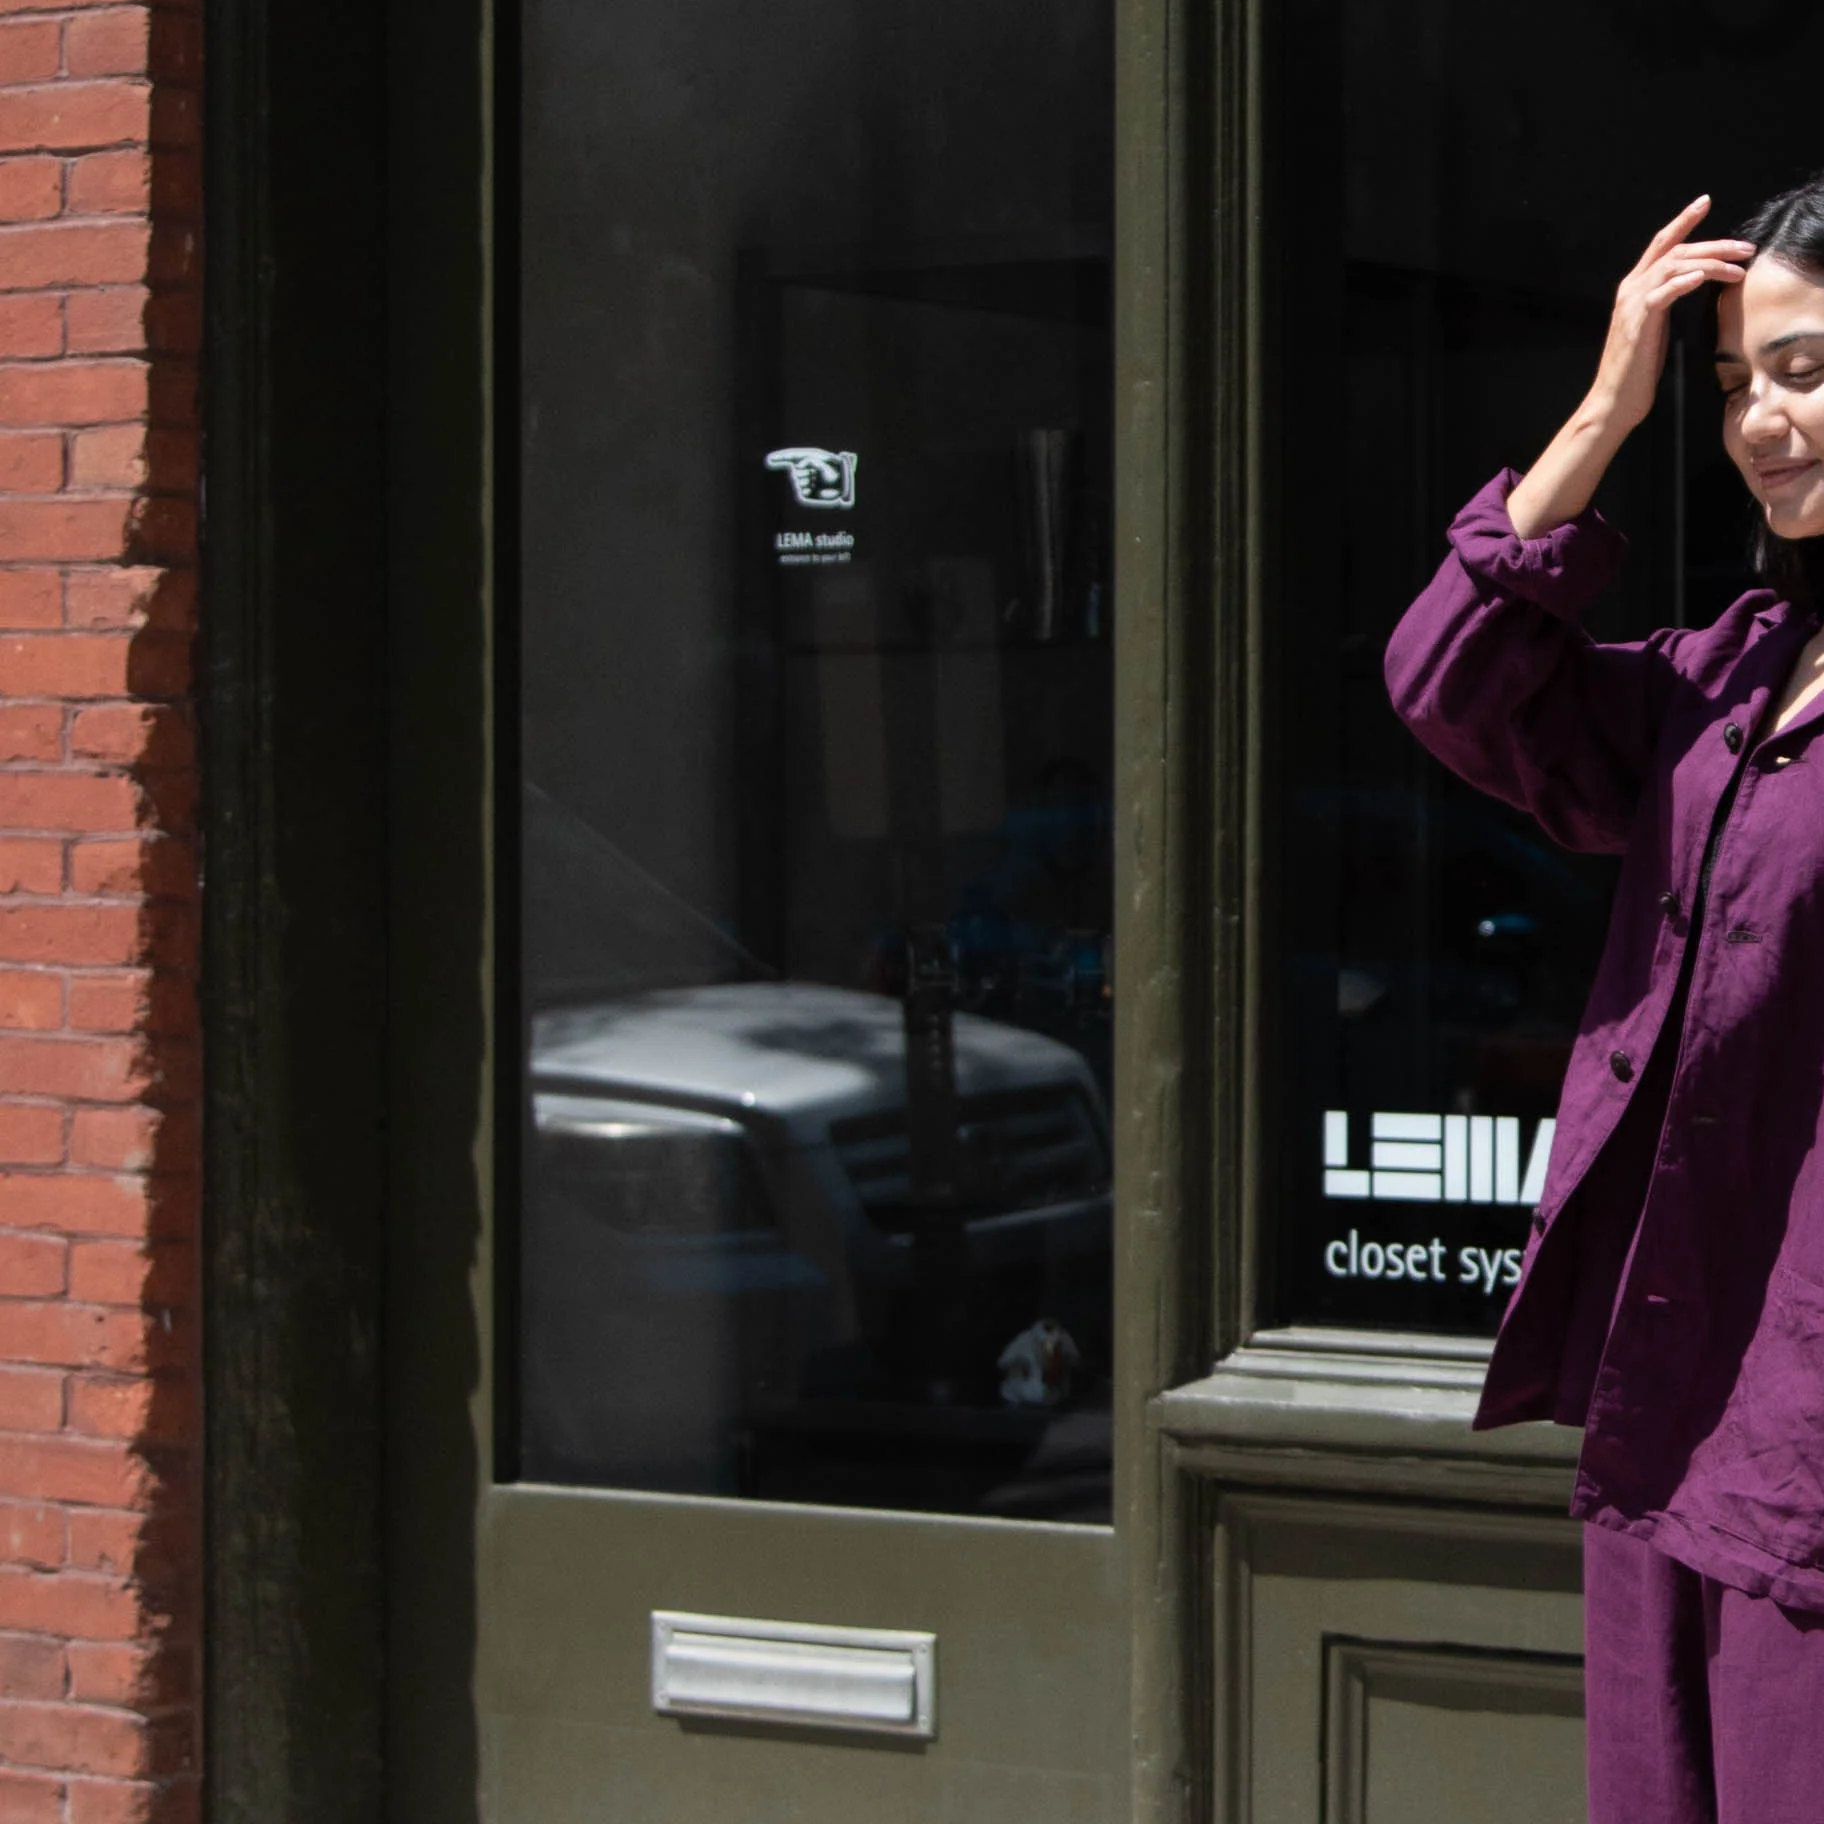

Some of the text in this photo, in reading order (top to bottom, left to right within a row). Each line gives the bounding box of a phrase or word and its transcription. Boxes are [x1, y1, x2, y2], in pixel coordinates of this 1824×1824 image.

[775, 530, 855, 549] LEMA studio
[1325, 1229, 1446, 1280] closet
[1459, 1246, 1527, 1295] sys
